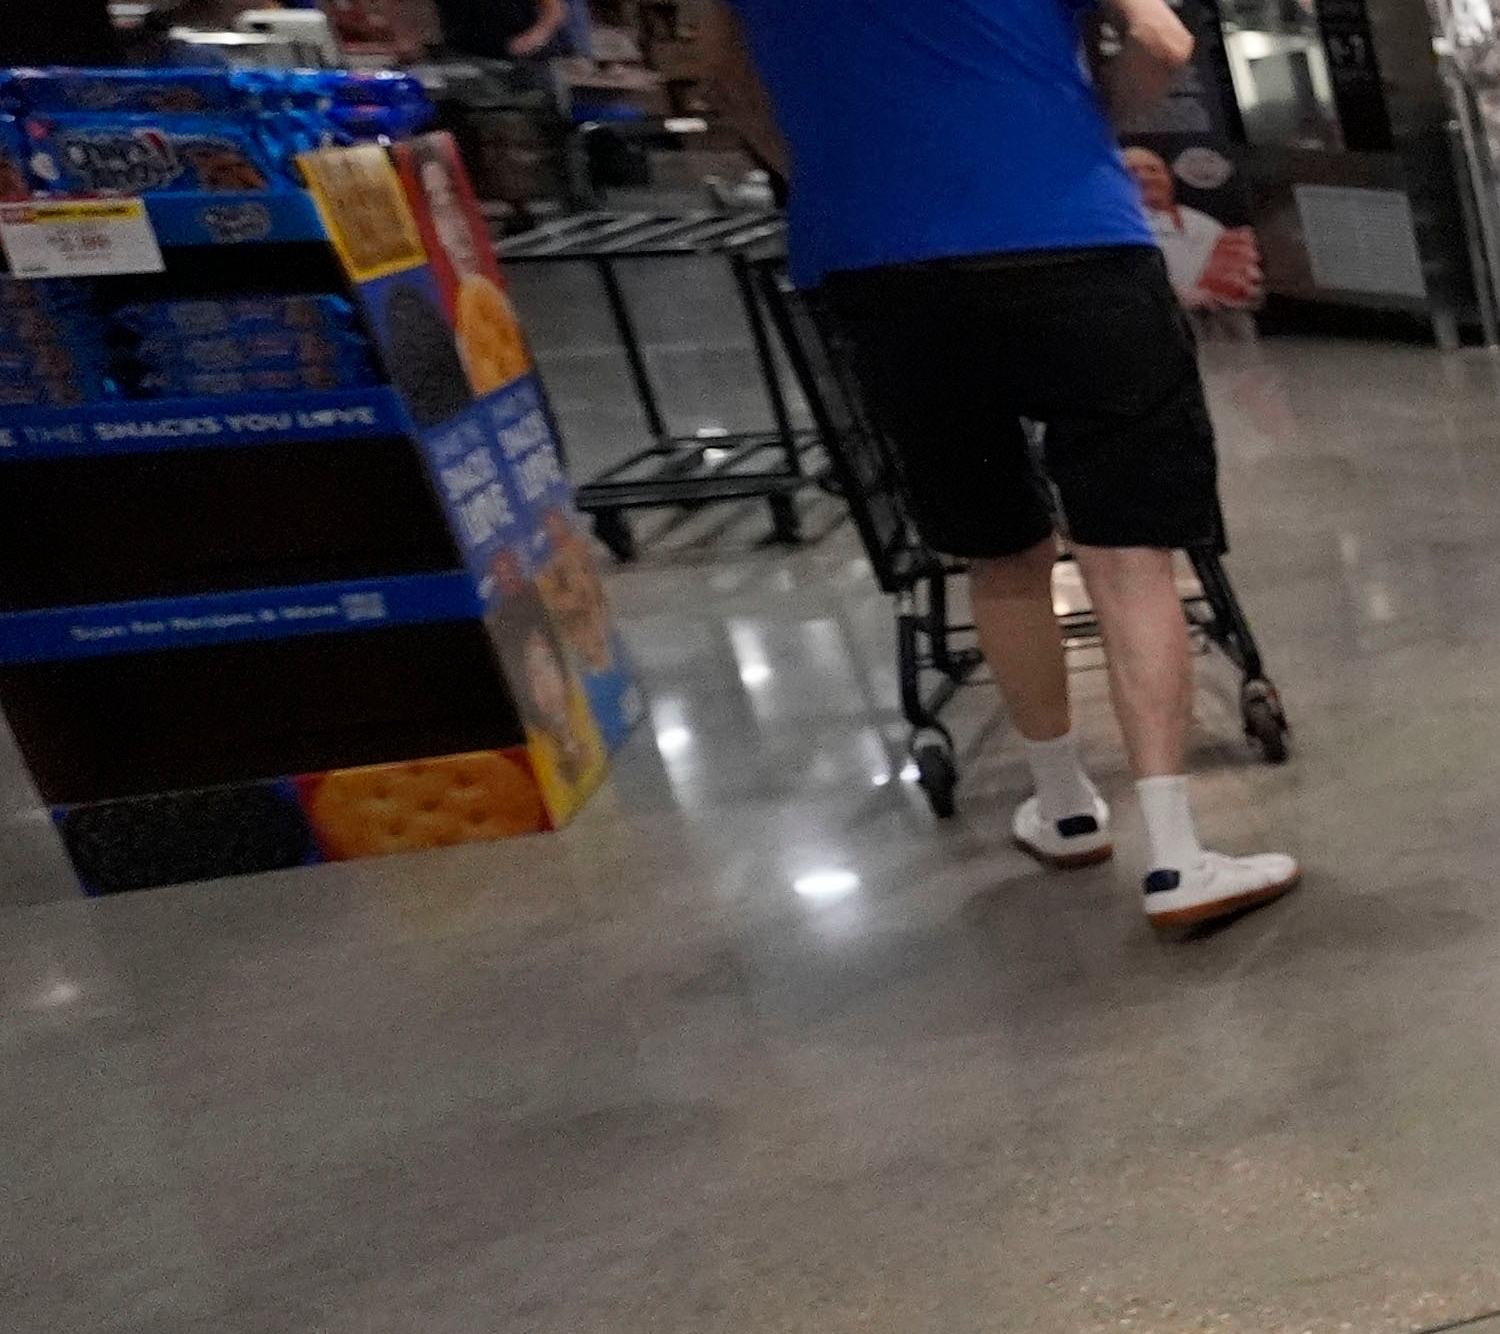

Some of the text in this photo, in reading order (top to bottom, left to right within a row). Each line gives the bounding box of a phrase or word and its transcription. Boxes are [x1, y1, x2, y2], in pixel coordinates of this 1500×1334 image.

[95, 415, 222, 442] SNACKS
[223, 408, 292, 432] YOU
[299, 406, 375, 429] LOVE
